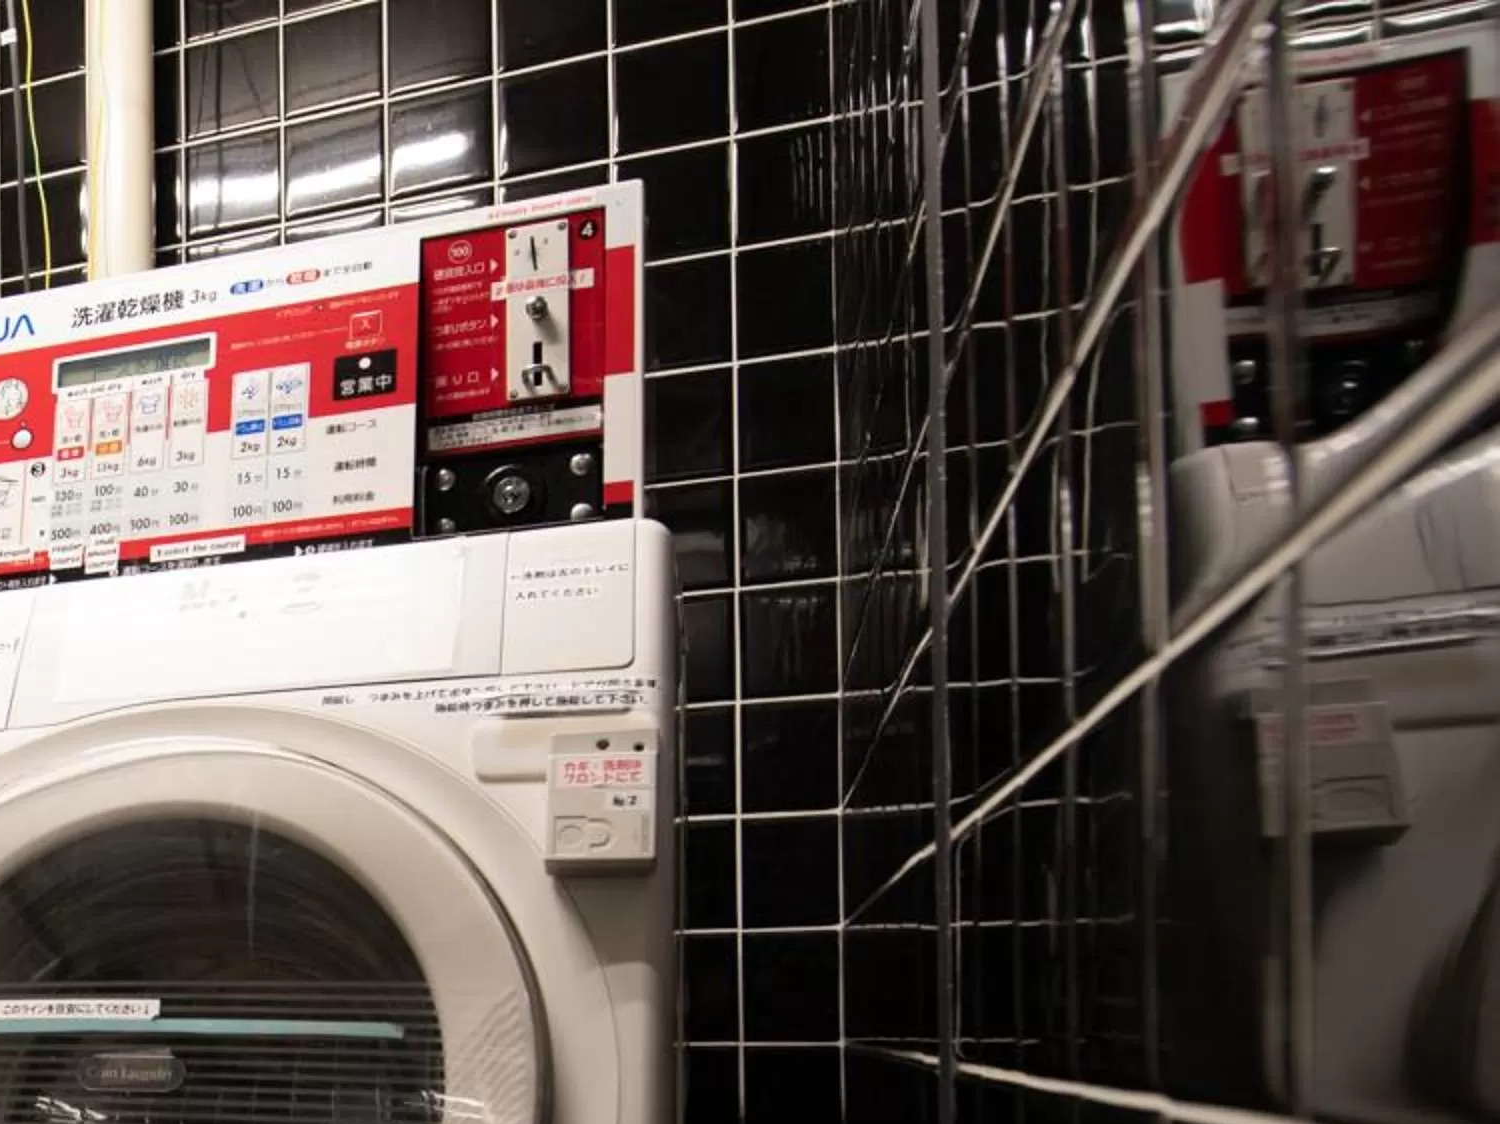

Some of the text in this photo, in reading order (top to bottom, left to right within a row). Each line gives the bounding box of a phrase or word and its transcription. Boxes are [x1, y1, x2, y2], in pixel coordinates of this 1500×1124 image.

[71, 290, 185, 329] 洗濯乾燥機
[339, 374, 393, 397] 営業中
